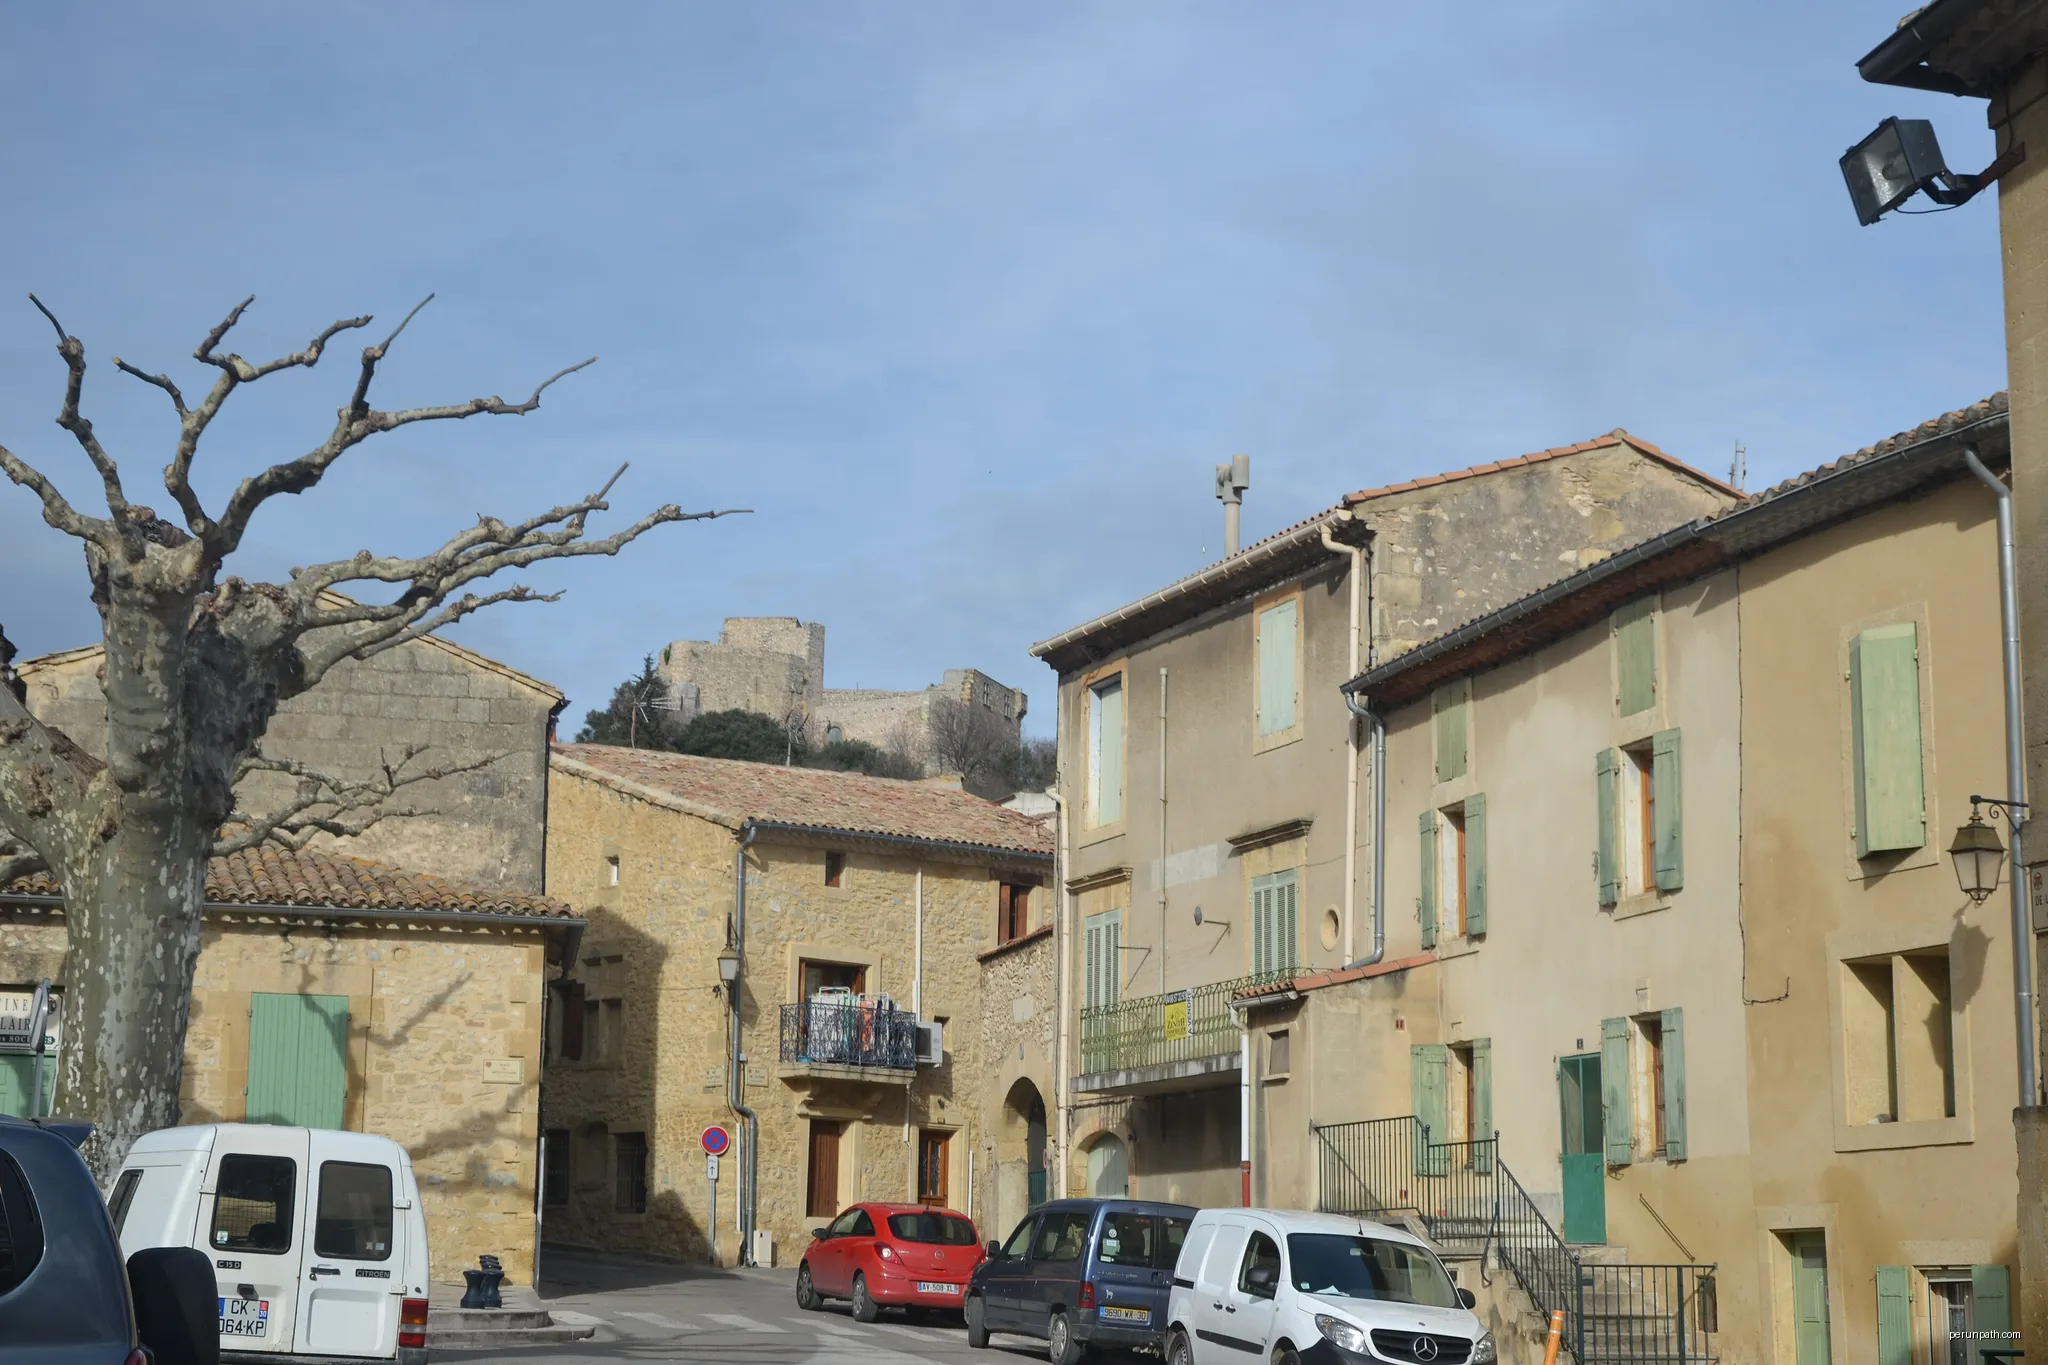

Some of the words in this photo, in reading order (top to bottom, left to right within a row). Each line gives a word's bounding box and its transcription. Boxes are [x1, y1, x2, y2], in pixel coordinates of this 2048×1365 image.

[0, 998, 28, 1011] INE
[0, 1017, 31, 1030] LAIR
[1137, 1311, 1146, 1320] 30
